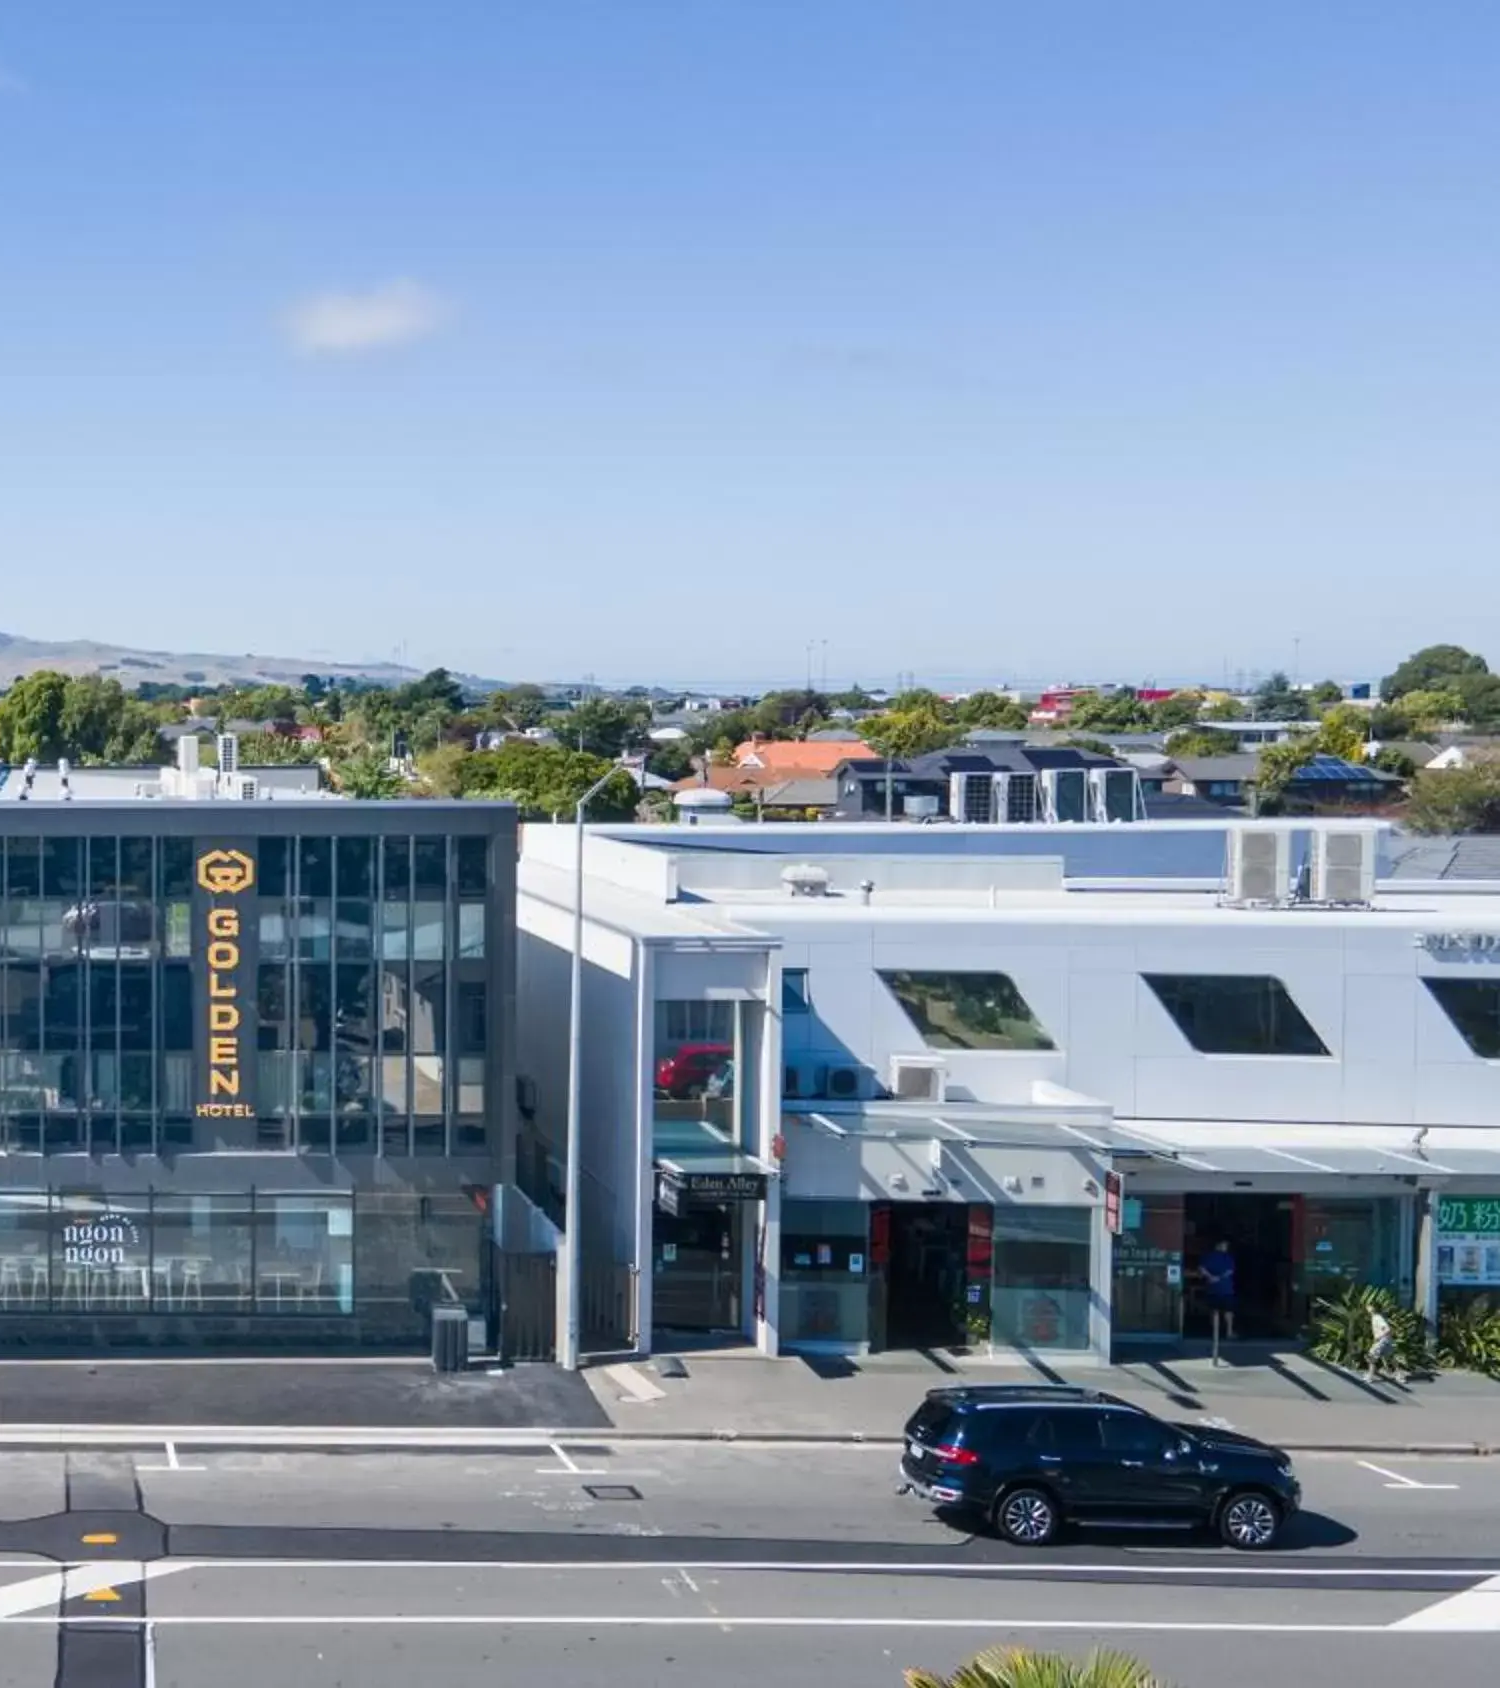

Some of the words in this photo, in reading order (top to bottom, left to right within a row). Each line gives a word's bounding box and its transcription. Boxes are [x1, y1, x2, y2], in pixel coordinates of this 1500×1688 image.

[207, 908, 240, 1096] GOLDEN
[196, 1103, 255, 1117] HOTEL
[691, 1176, 723, 1190] Eden
[1440, 1200, 1500, 1230] 奶粉
[63, 1224, 124, 1245] ngon
[65, 1245, 124, 1266] ngon
